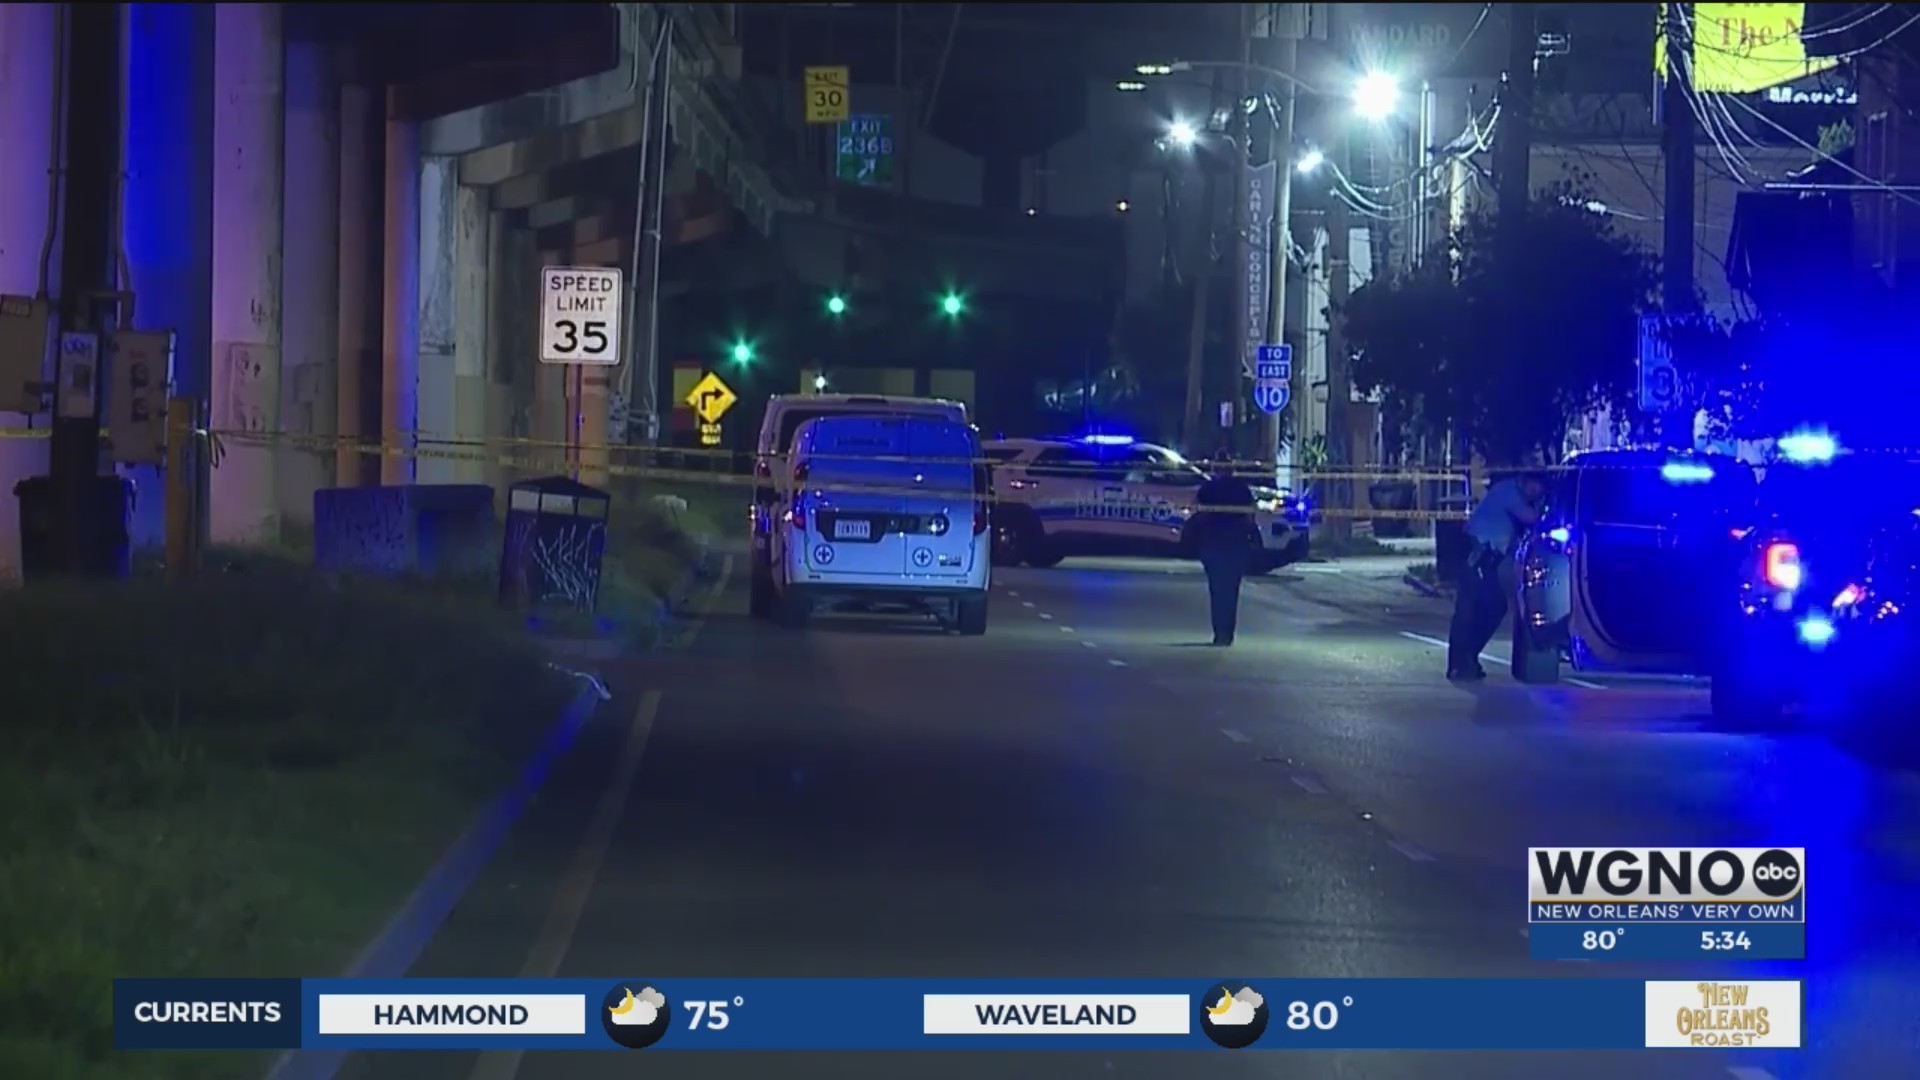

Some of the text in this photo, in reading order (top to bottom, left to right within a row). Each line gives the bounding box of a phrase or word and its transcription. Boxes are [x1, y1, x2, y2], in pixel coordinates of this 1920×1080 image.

[1716, 17, 1775, 47] The
[814, 90, 842, 107] 30
[851, 119, 881, 133] EXIT
[551, 275, 613, 292] SPEED
[556, 296, 606, 312] LIMIT
[553, 320, 608, 354] 35
[1265, 347, 1283, 360] TO
[1261, 365, 1286, 378] EAST
[1261, 387, 1283, 407] 10
